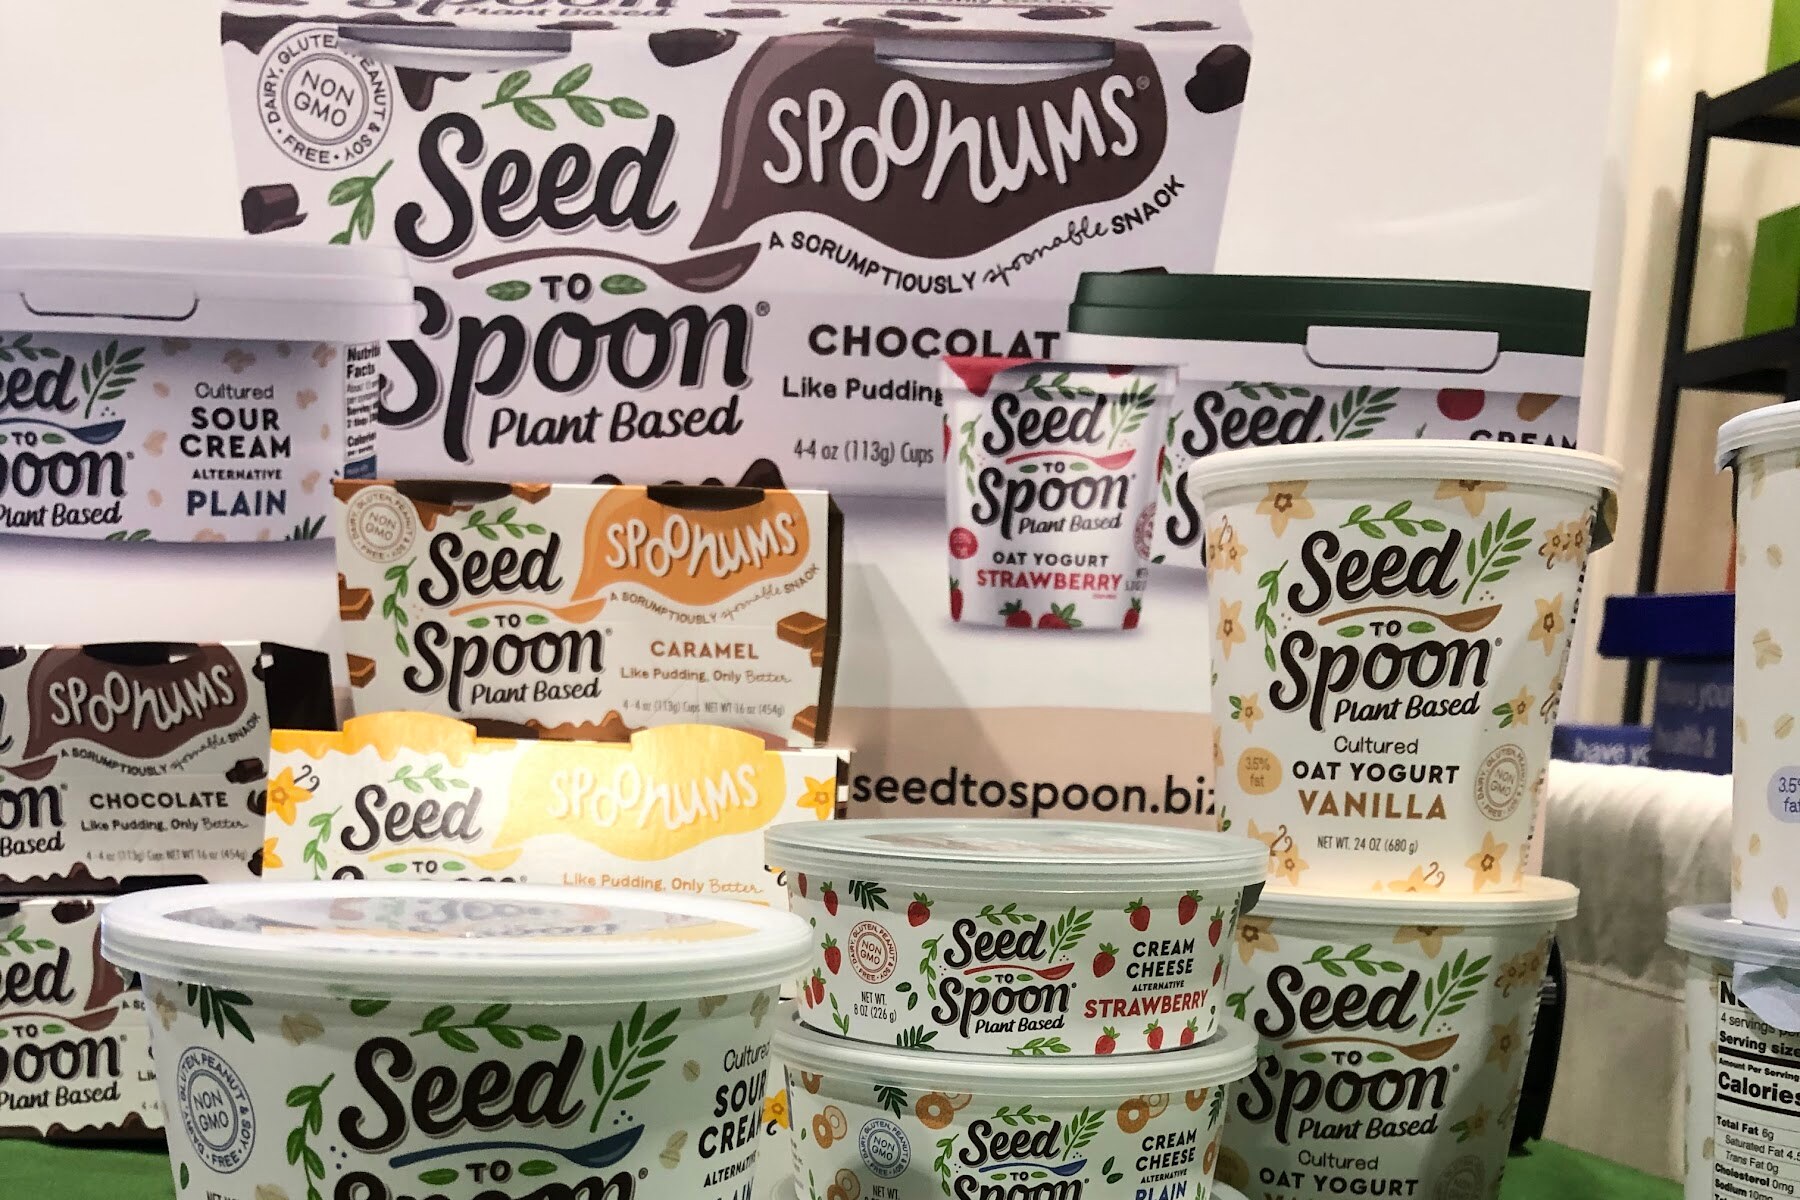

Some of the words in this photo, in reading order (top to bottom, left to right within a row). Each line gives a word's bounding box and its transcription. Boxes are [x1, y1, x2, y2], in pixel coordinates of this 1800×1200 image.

[301, 70, 355, 106] NON
[294, 92, 347, 127] GMO
[395, 112, 678, 258] Seed
[769, 231, 785, 249] A
[983, 215, 1109, 287] spoonable
[540, 272, 592, 301] TO
[378, 286, 752, 464] Spoon
[195, 381, 274, 400] Cultured
[783, 378, 837, 399] Like
[191, 407, 279, 431] SOUR
[488, 406, 603, 449] Plant
[611, 395, 744, 443] Based
[983, 392, 1107, 455] Seed
[180, 434, 291, 459] CREAM
[821, 444, 837, 459] oz
[843, 439, 896, 465] (113g)
[902, 442, 934, 466] Cups
[192, 468, 282, 481] ALTERNATIVE
[1043, 462, 1065, 473] TO
[52, 501, 122, 527] Based
[187, 489, 287, 516] PLAIN
[972, 467, 1128, 540] Spoon
[1018, 516, 1066, 534] Plant
[1070, 513, 1123, 532] Based
[418, 531, 565, 608] Seed
[993, 552, 1027, 565] OAT
[1033, 553, 1109, 567] YOGURT
[1287, 528, 1462, 613] Seed
[977, 569, 1123, 591] STRAWBERRY
[495, 614, 520, 628] TO
[1370, 621, 1402, 636] TO
[651, 641, 759, 660] CARAMEL
[404, 621, 604, 712] Spoon
[621, 667, 649, 679] Like
[653, 667, 709, 683] Pudding,
[714, 670, 741, 682] Only
[471, 685, 529, 706] Plant
[534, 678, 602, 703] Based
[1269, 630, 1490, 731] Spoon
[1334, 697, 1402, 723] Plant
[1406, 692, 1480, 719] Based
[1334, 735, 1419, 755] Cultured
[1292, 762, 1341, 780] OAT
[1350, 763, 1460, 784] YOGURT
[90, 792, 228, 809] CHOCOLATE
[1298, 790, 1446, 820] VANILLA
[341, 783, 483, 852] Seed
[1318, 836, 1334, 849] NET
[1336, 837, 1351, 850] WT.
[1354, 838, 1366, 851] 24
[1369, 838, 1380, 851] OZ
[1384, 838, 1407, 853] (680
[1409, 840, 1418, 856] g)
[412, 861, 438, 873] TO
[563, 873, 596, 887] Like
[671, 878, 704, 893] Only
[862, 940, 882, 955] NON
[944, 919, 1047, 968] Seed
[1133, 938, 1195, 957] CREAM
[861, 950, 881, 966] GMO
[1126, 959, 1194, 978] CHEESE
[995, 974, 1014, 983] TO
[1132, 980, 1184, 992] ALTERNATIVE
[861, 991, 873, 1004] NET
[875, 993, 887, 1005] WT.
[932, 977, 1069, 1038] Spoon
[1084, 989, 1208, 1019] STRAWBERRY
[1254, 965, 1420, 1038] Seed
[854, 1004, 859, 1015] 8
[861, 1005, 868, 1016] OZ
[871, 1007, 887, 1020] (226
[889, 1009, 897, 1023] g)
[975, 1019, 1016, 1034] Plant
[1018, 1015, 1064, 1032] Based
[1720, 1030, 1766, 1053] Serving
[1771, 1043, 1800, 1057] size
[1332, 1051, 1362, 1066] TO
[1765, 1068, 1800, 1081] Serving
[56, 1081, 121, 1107] Based
[193, 1090, 223, 1111] NON
[338, 1034, 585, 1152] Seed
[713, 1069, 767, 1118] SOUR
[1236, 1055, 1449, 1145] Spoon
[199, 1111, 229, 1133] GMO
[1298, 1118, 1363, 1140] Plant
[1366, 1114, 1438, 1139] Based
[1717, 1116, 1738, 1130] Total
[1742, 1123, 1759, 1135] Fat
[1762, 1128, 1774, 1141] 6g
[959, 1119, 1061, 1167] Seed
[1142, 1128, 1197, 1151] CREAM
[1136, 1147, 1195, 1171] CHEESE
[1298, 1150, 1379, 1170] Cultured
[466, 1160, 513, 1183] TO
[1010, 1172, 1029, 1181] TO
[1141, 1169, 1187, 1184] ALTERNATIVE
[1260, 1167, 1305, 1189] OAT
[1314, 1175, 1418, 1196] YOGURT
[1715, 1163, 1769, 1187] Cholesterol
[1772, 1179, 1794, 1194] 0mg
[872, 1185, 885, 1198] NET
[1715, 1179, 1747, 1197] Sodium
